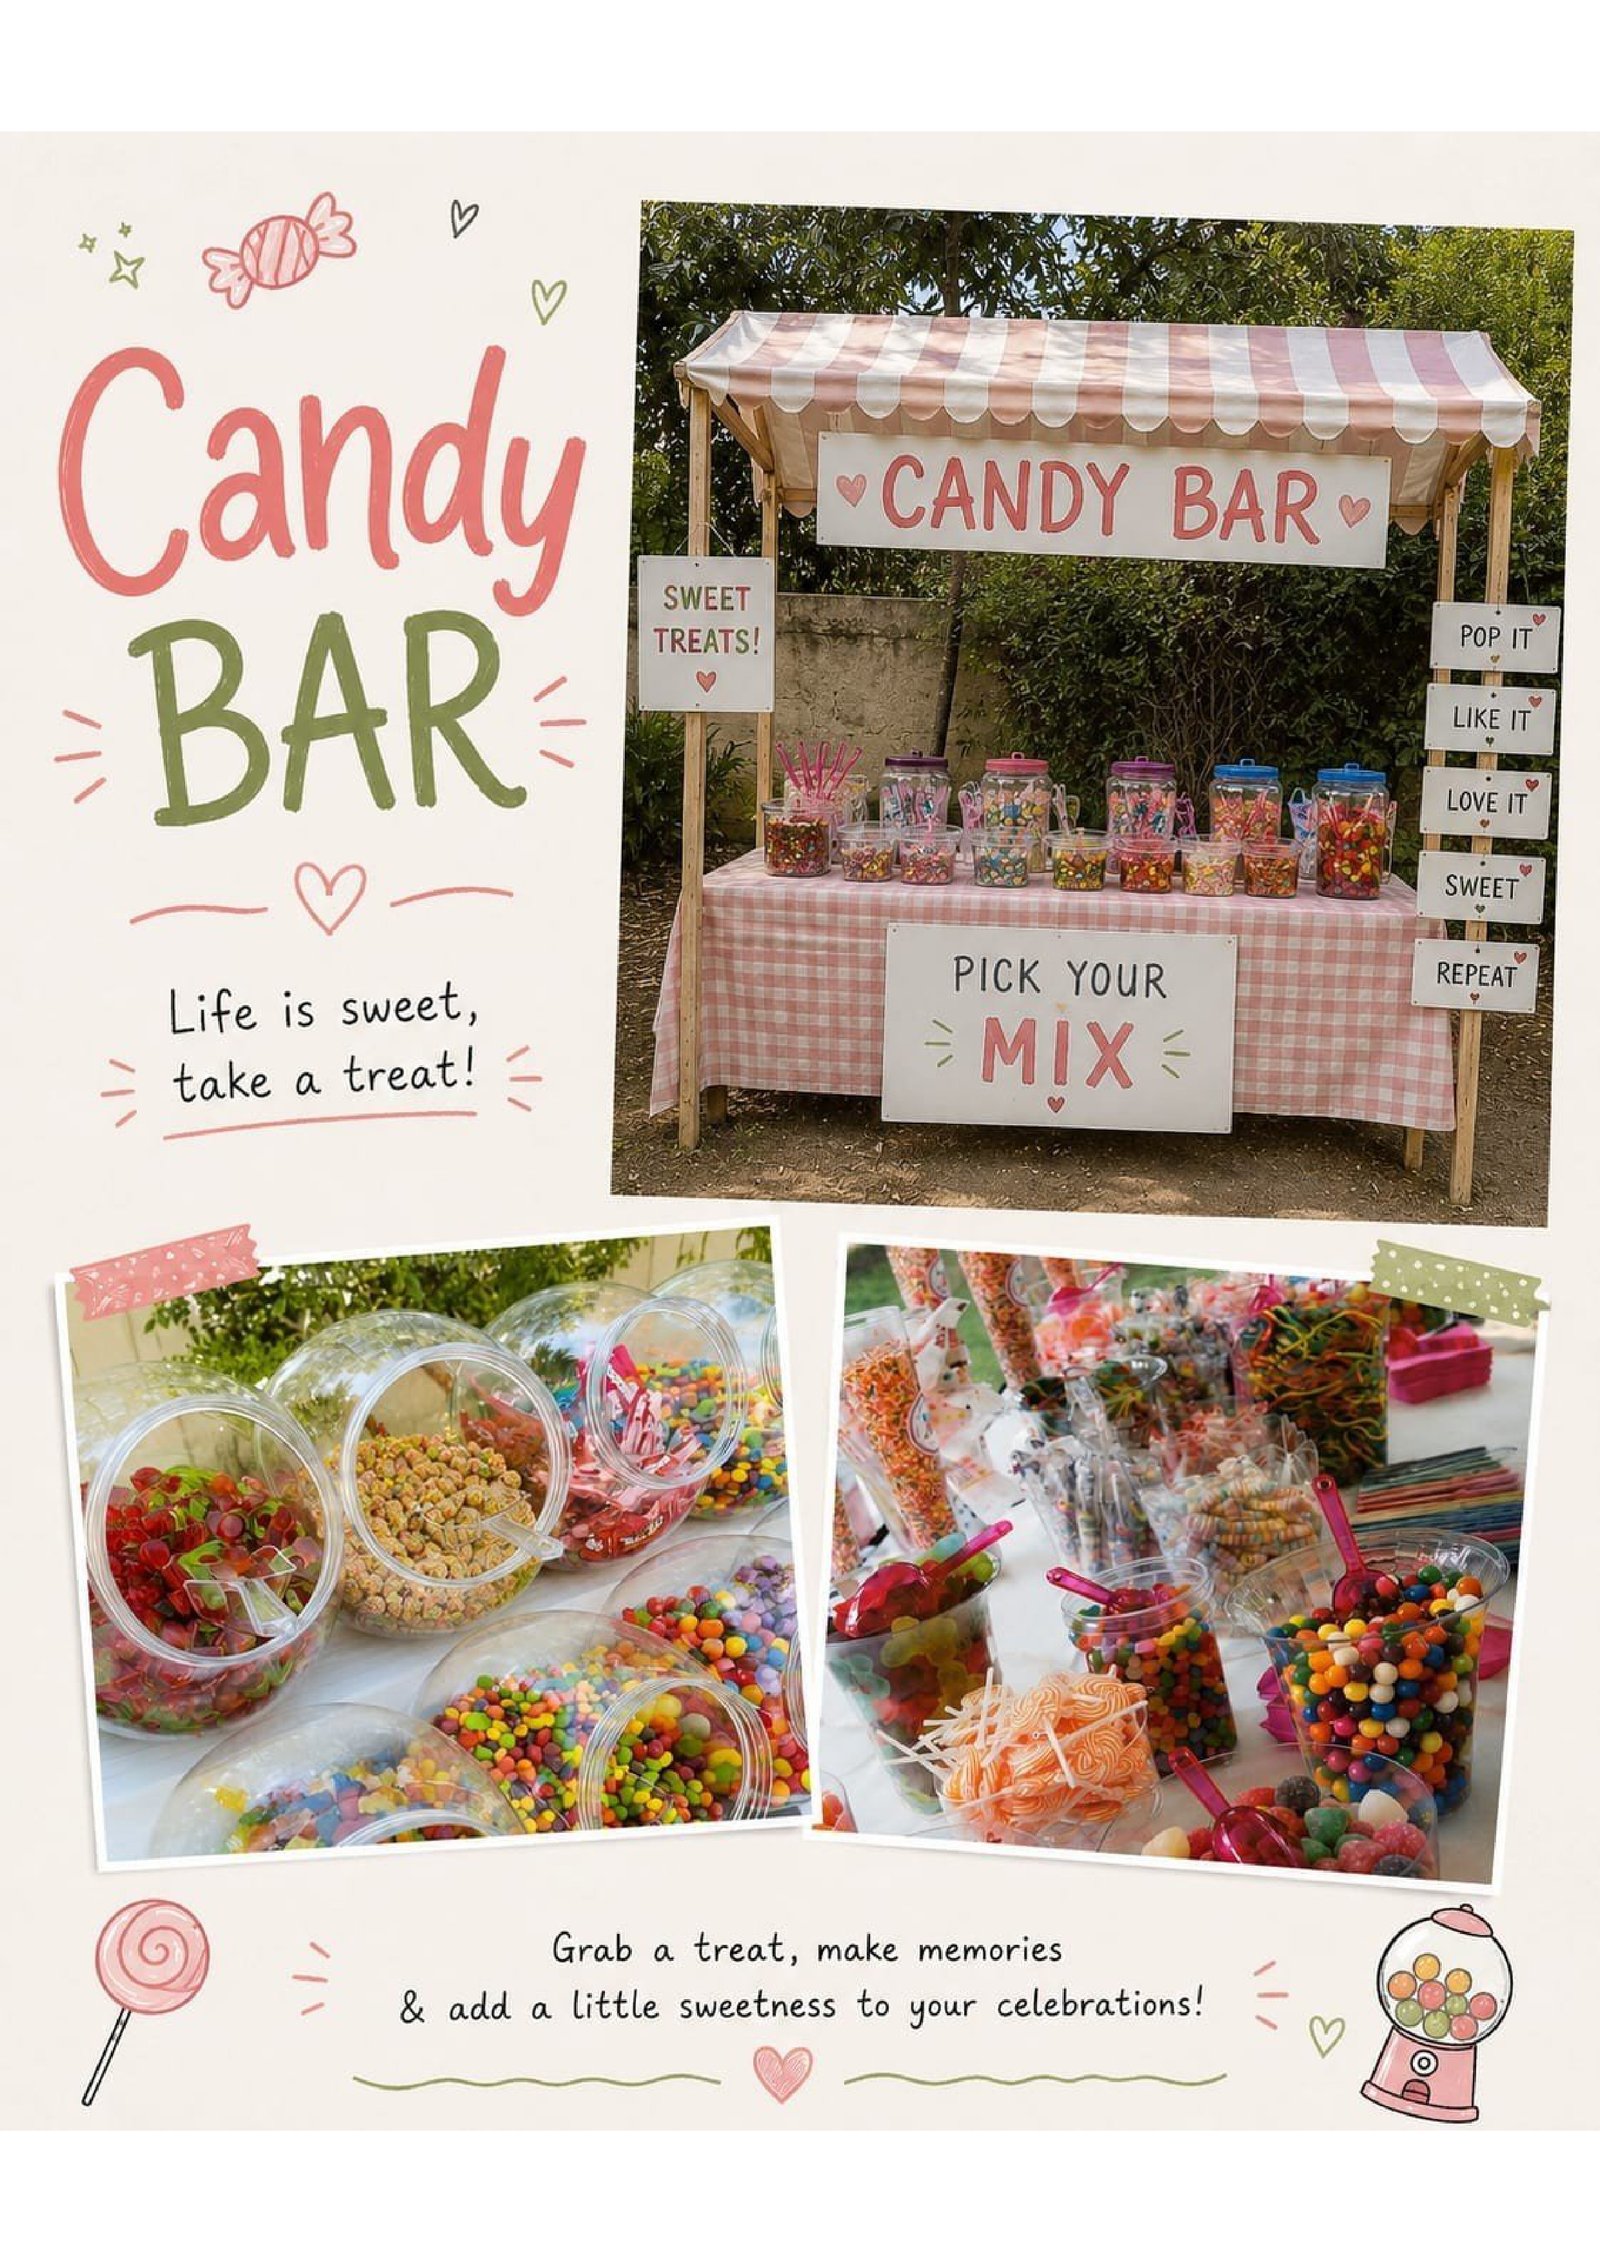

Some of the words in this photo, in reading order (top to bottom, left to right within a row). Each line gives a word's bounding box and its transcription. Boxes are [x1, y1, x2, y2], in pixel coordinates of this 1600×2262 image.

[883, 455, 1129, 536] CANDY
[1174, 466, 1320, 544] BAR
[664, 585, 751, 611] SWEET
[654, 627, 759, 655] TREATS!
[1462, 624, 1500, 648] POP
[1513, 628, 1534, 649] IT
[1453, 706, 1500, 729] LIKE
[1512, 710, 1531, 731] IT
[1447, 789, 1498, 813] LOVE
[1508, 793, 1528, 814] IT
[1446, 874, 1520, 899] SWEET
[954, 956, 1040, 993] PICK
[1067, 961, 1167, 998] YOUR
[1437, 962, 1518, 987] REPEAT
[983, 1017, 1133, 1089] MIX
